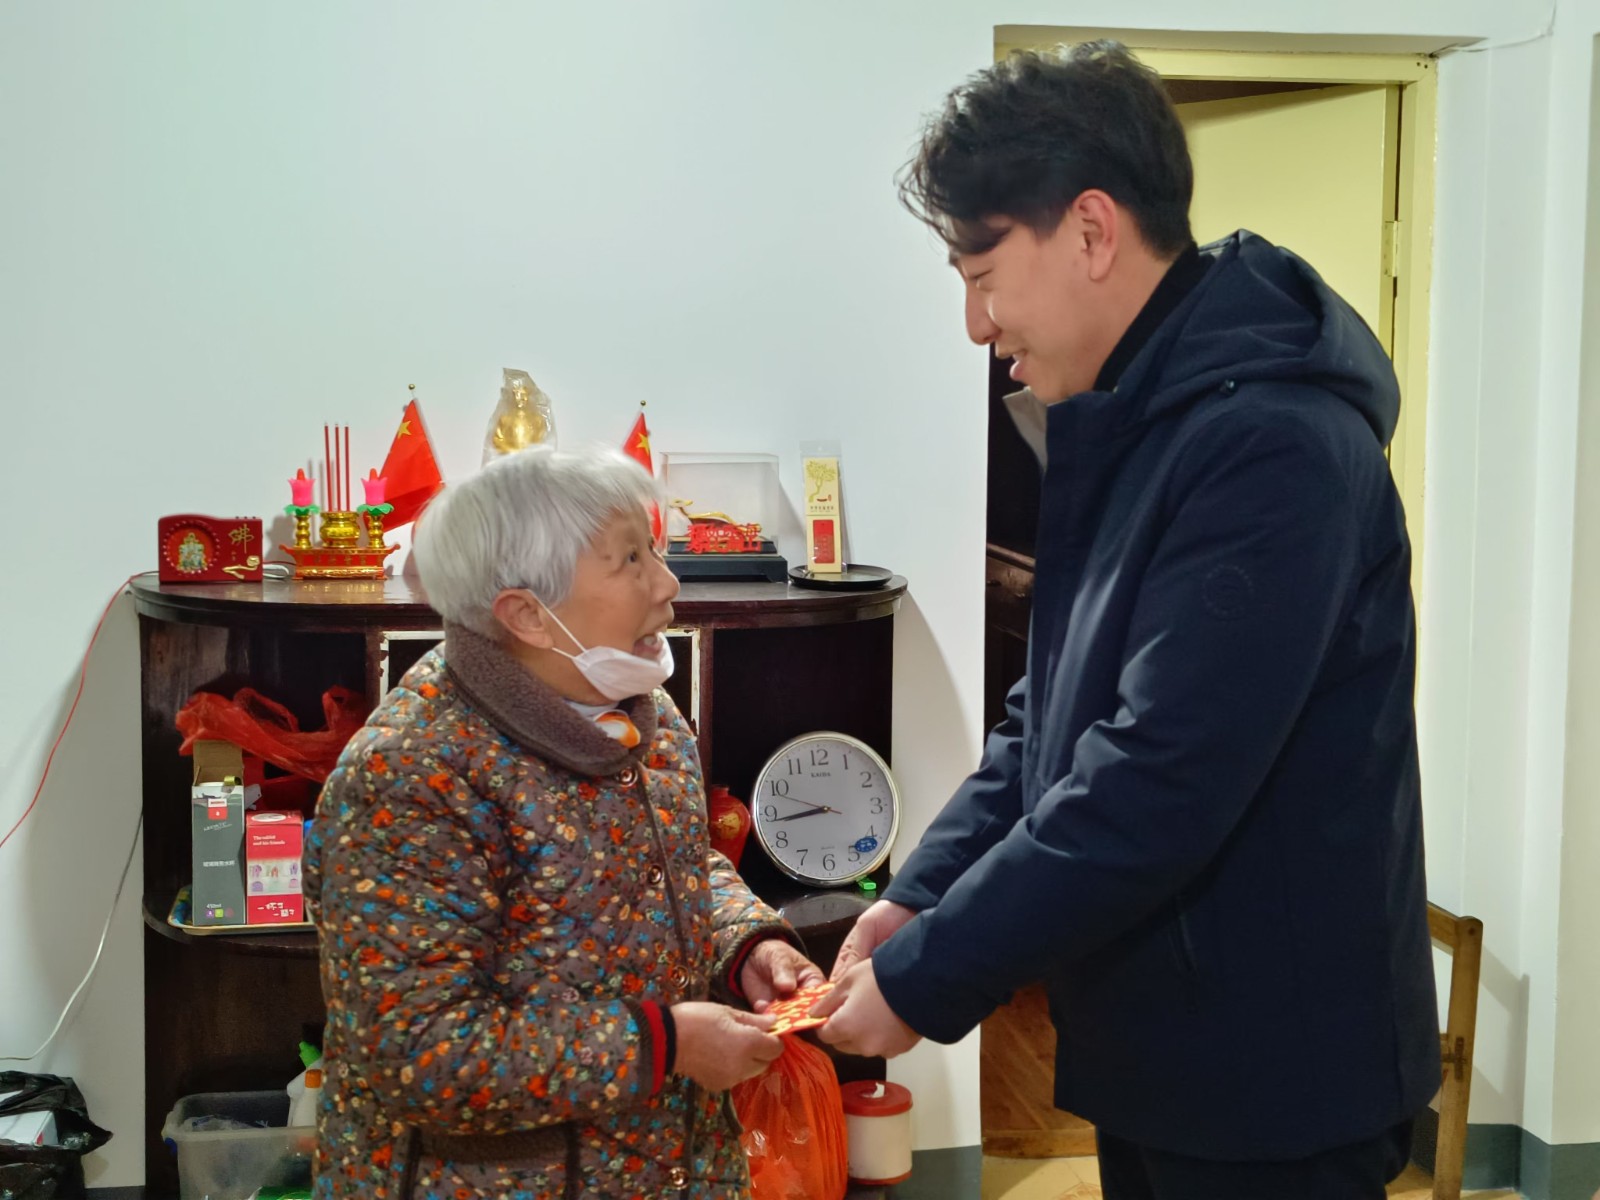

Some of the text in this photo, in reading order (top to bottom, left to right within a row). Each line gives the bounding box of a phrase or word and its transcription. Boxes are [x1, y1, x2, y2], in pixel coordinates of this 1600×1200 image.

[810, 749, 829, 766] 12
[843, 754, 849, 770] 1
[788, 758, 802, 775] 11
[771, 779, 789, 796] 10
[860, 771, 873, 788] 2
[764, 805, 778, 823] 9
[870, 797, 883, 815] 3
[776, 831, 788, 849] 8
[796, 849, 809, 866] 7
[848, 845, 860, 862] 5
[822, 854, 836, 871] 6
